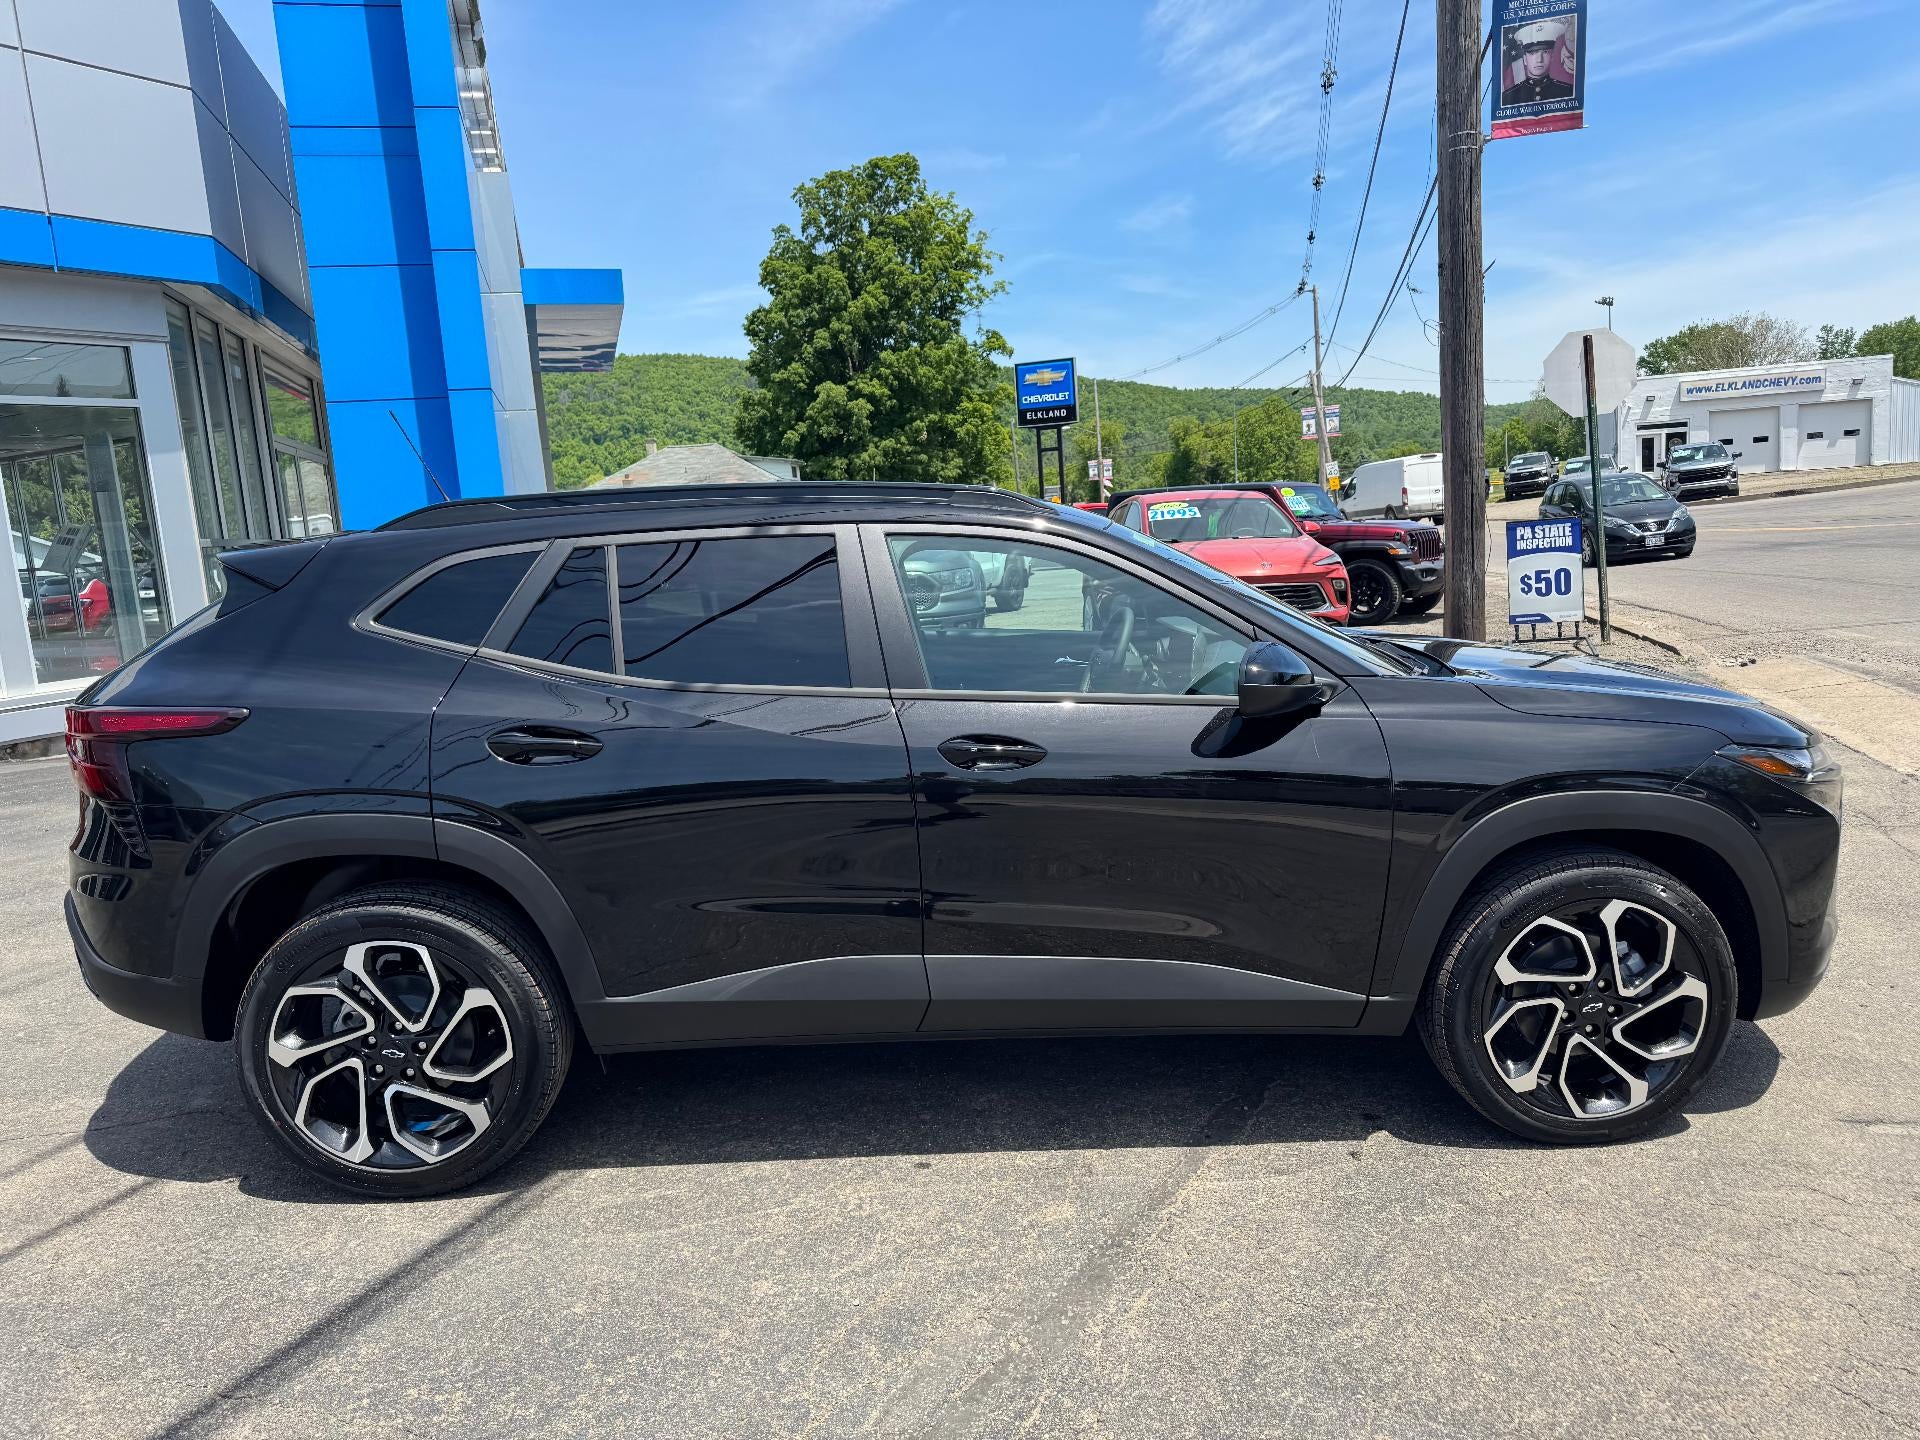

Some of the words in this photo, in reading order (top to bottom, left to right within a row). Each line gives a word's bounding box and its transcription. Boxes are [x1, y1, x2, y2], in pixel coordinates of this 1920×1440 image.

[1517, 7, 1549, 17] MARINE
[1550, 2, 1577, 12] CORPS
[1496, 108, 1519, 117] GLOBAL
[1686, 375, 1822, 395] www.ELKLANDCHEVY.com
[1022, 392, 1070, 404] CHEVROLET
[1026, 409, 1067, 420] ELKLAND
[1150, 506, 1198, 520] 21995
[1516, 526, 1533, 540] PA
[1534, 523, 1572, 538] STATE
[1516, 536, 1573, 550] INSPECTION
[1519, 567, 1572, 597] $50
